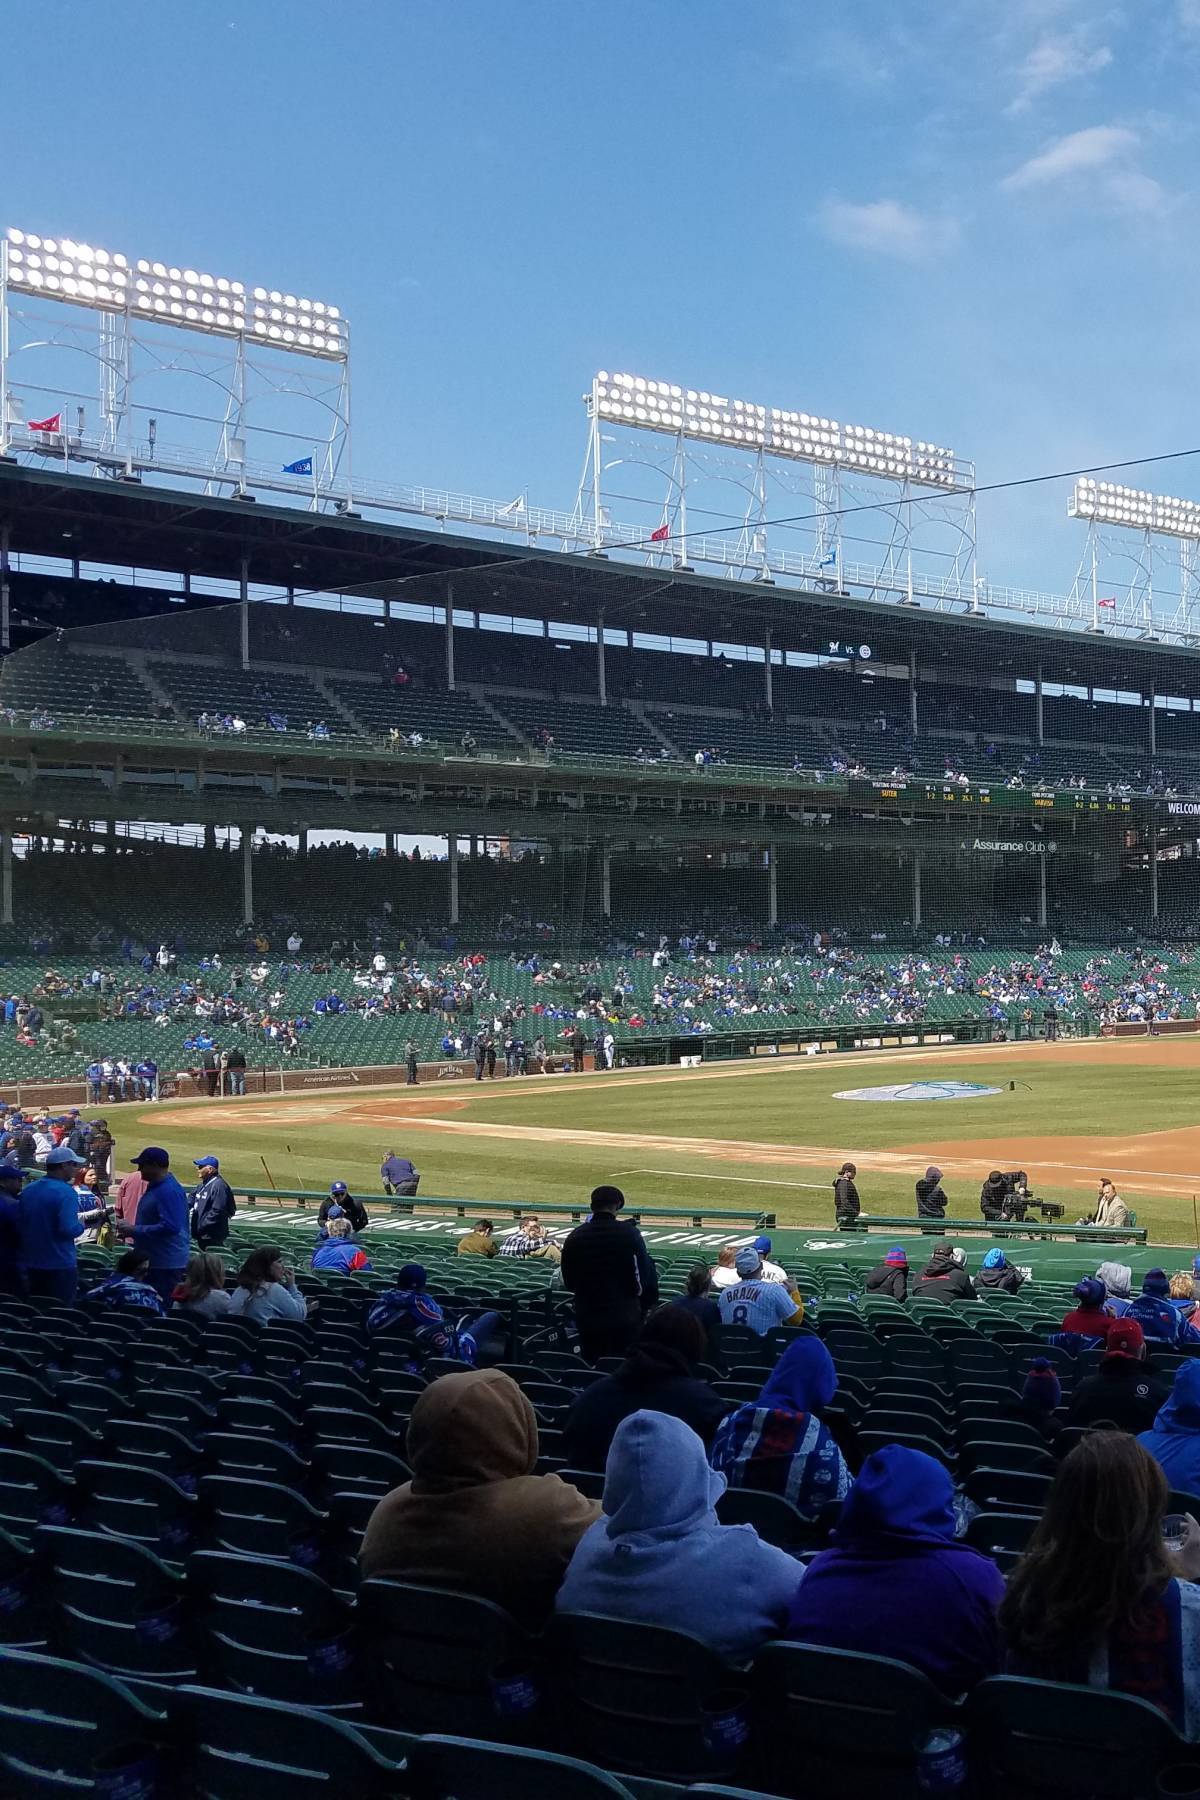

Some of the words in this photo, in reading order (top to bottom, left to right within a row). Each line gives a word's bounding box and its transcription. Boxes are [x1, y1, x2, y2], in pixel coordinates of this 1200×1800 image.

[881, 790, 897, 798] SUTER
[973, 839, 1024, 851] Assurance
[1025, 841, 1046, 852] Club
[304, 1075, 330, 1083] American
[726, 1286, 761, 1303] BRAUN
